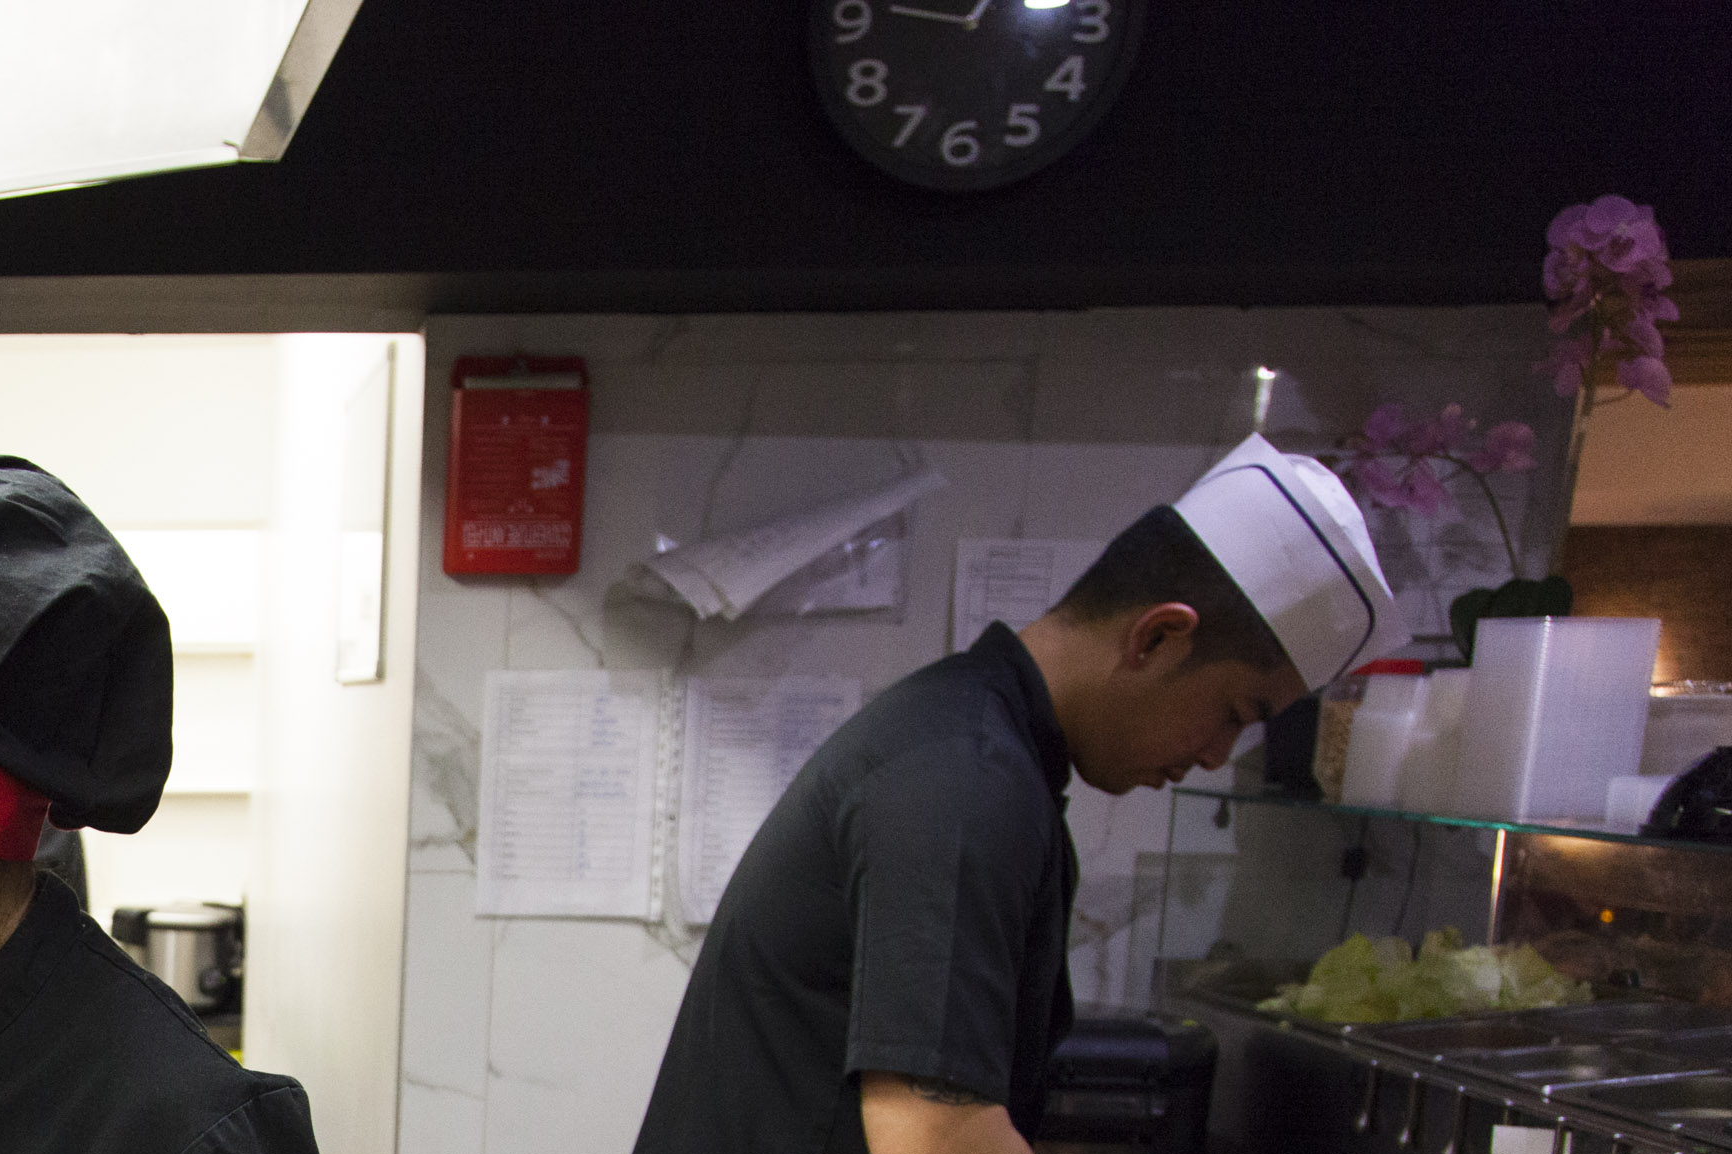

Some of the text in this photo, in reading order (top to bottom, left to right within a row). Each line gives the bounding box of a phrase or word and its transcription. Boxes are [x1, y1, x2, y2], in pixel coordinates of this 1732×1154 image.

[834, 0, 872, 44] 9
[1073, 0, 1111, 43] 3
[845, 58, 888, 106] 8
[1044, 54, 1085, 100] 4
[893, 104, 927, 147] 7
[942, 120, 979, 166] 6
[1005, 103, 1040, 147] 5
